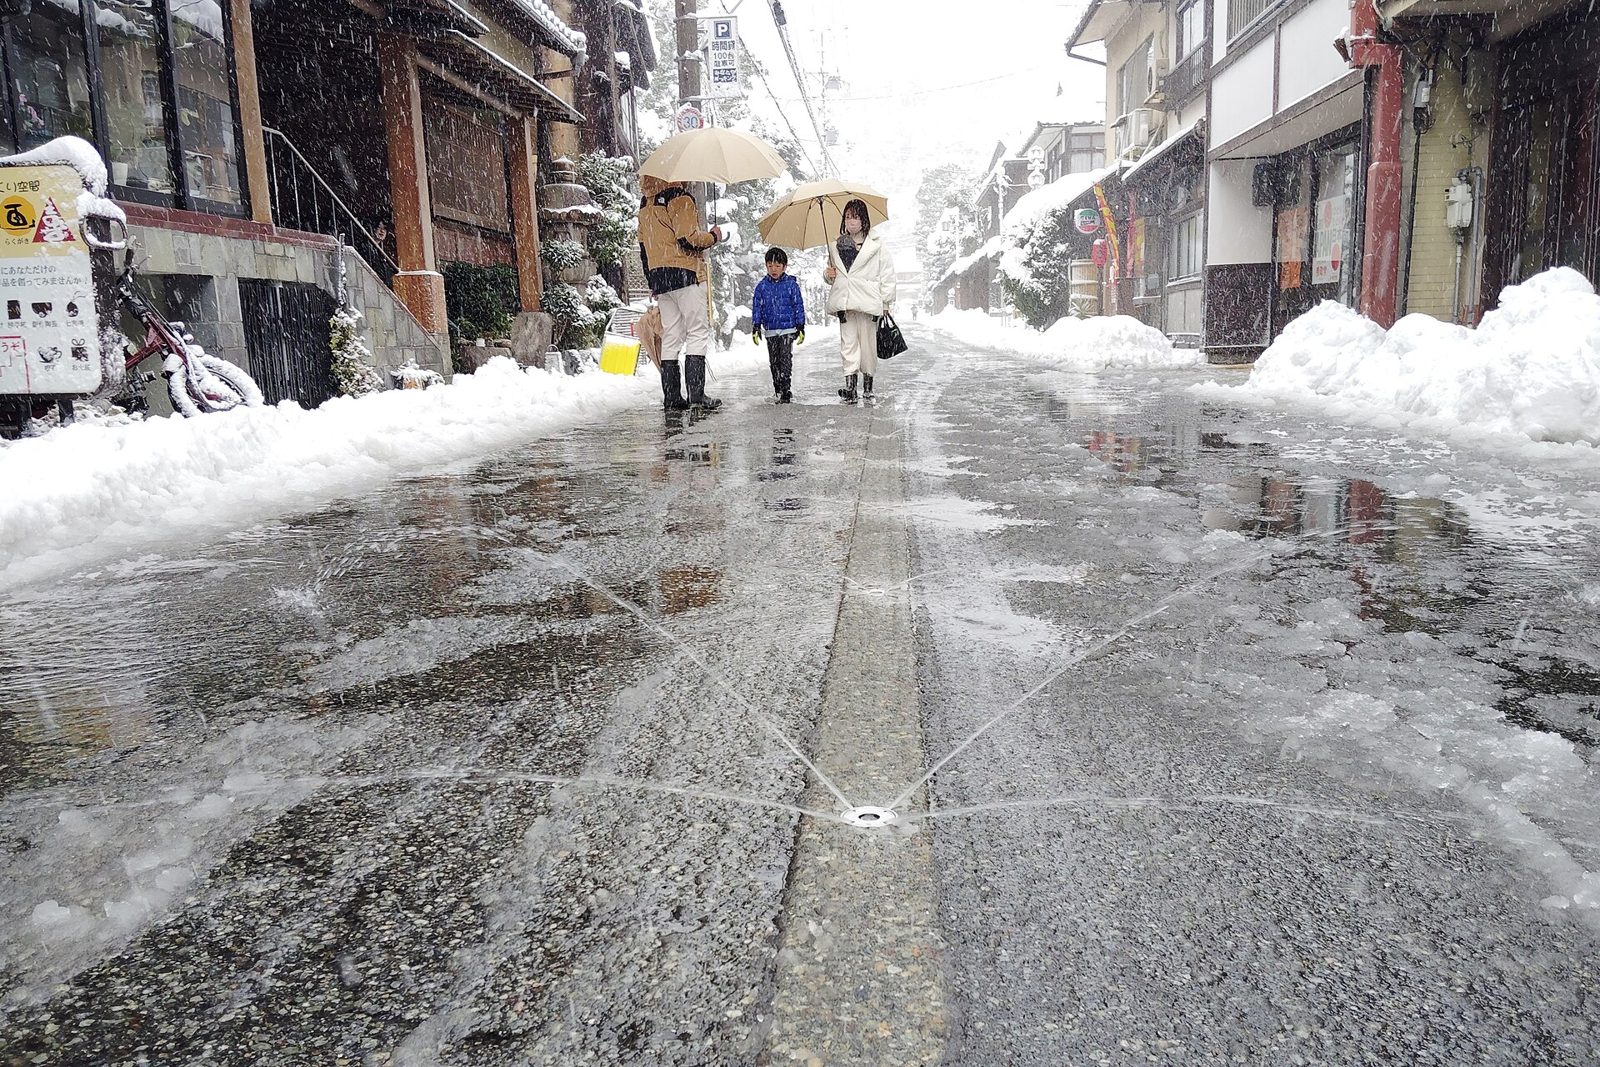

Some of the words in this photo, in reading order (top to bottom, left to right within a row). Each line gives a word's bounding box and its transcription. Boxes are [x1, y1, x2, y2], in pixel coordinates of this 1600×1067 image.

[717, 24, 728, 37] P
[712, 40, 735, 51] 時間貸
[683, 116, 698, 129] 30
[4, 238, 30, 246] らくがき
